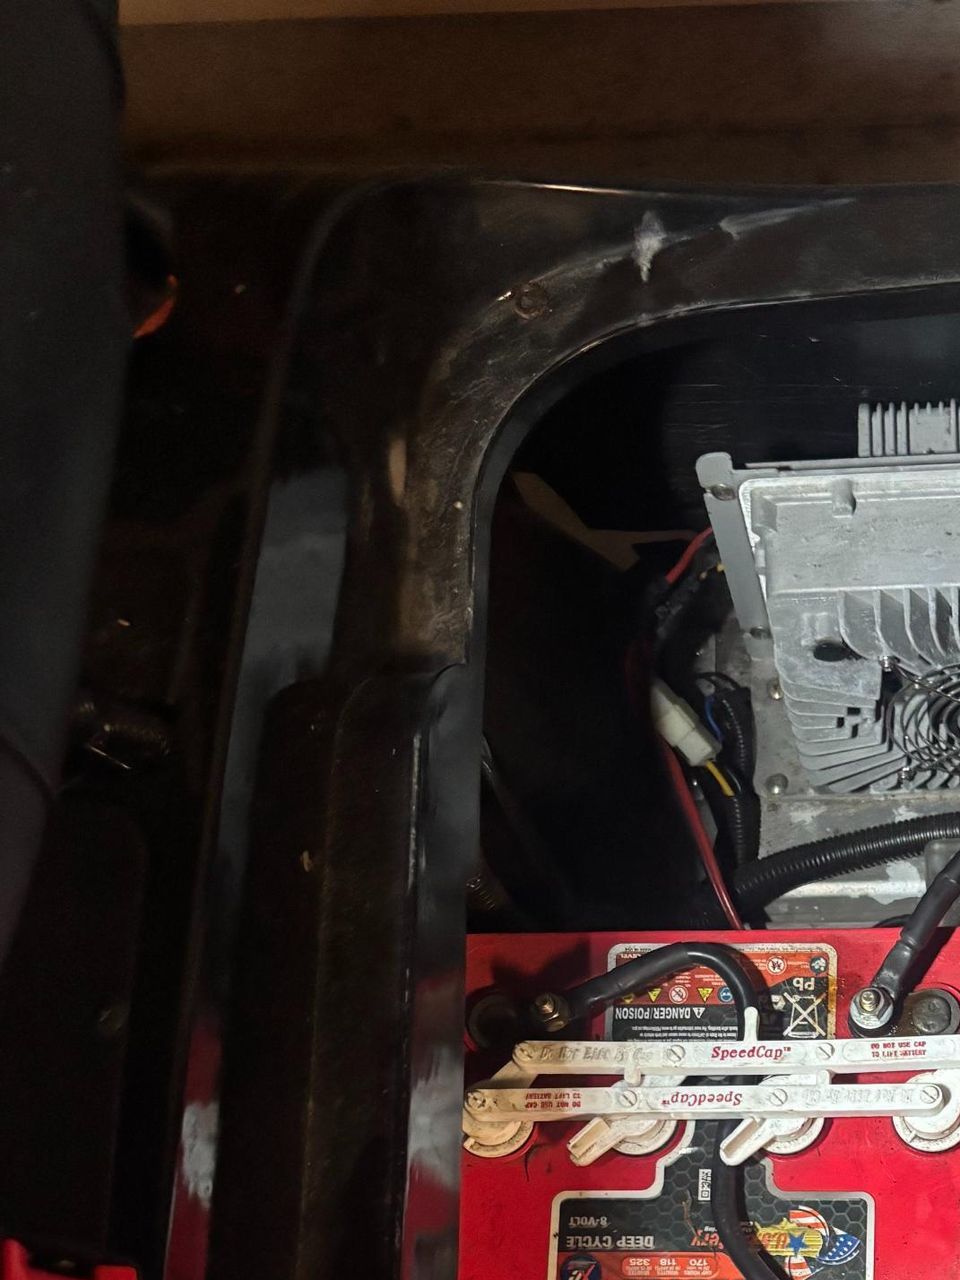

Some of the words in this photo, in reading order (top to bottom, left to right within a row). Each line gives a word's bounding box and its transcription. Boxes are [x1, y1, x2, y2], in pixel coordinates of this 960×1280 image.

[791, 976, 816, 992] Pb
[615, 1006, 691, 1020] DANGER/POISON
[568, 1216, 608, 1227] 8-VOLT
[566, 1236, 612, 1248] CYCLE
[616, 1235, 655, 1248] DEEP
[629, 1259, 650, 1267] 325
[689, 1259, 709, 1267] 170
